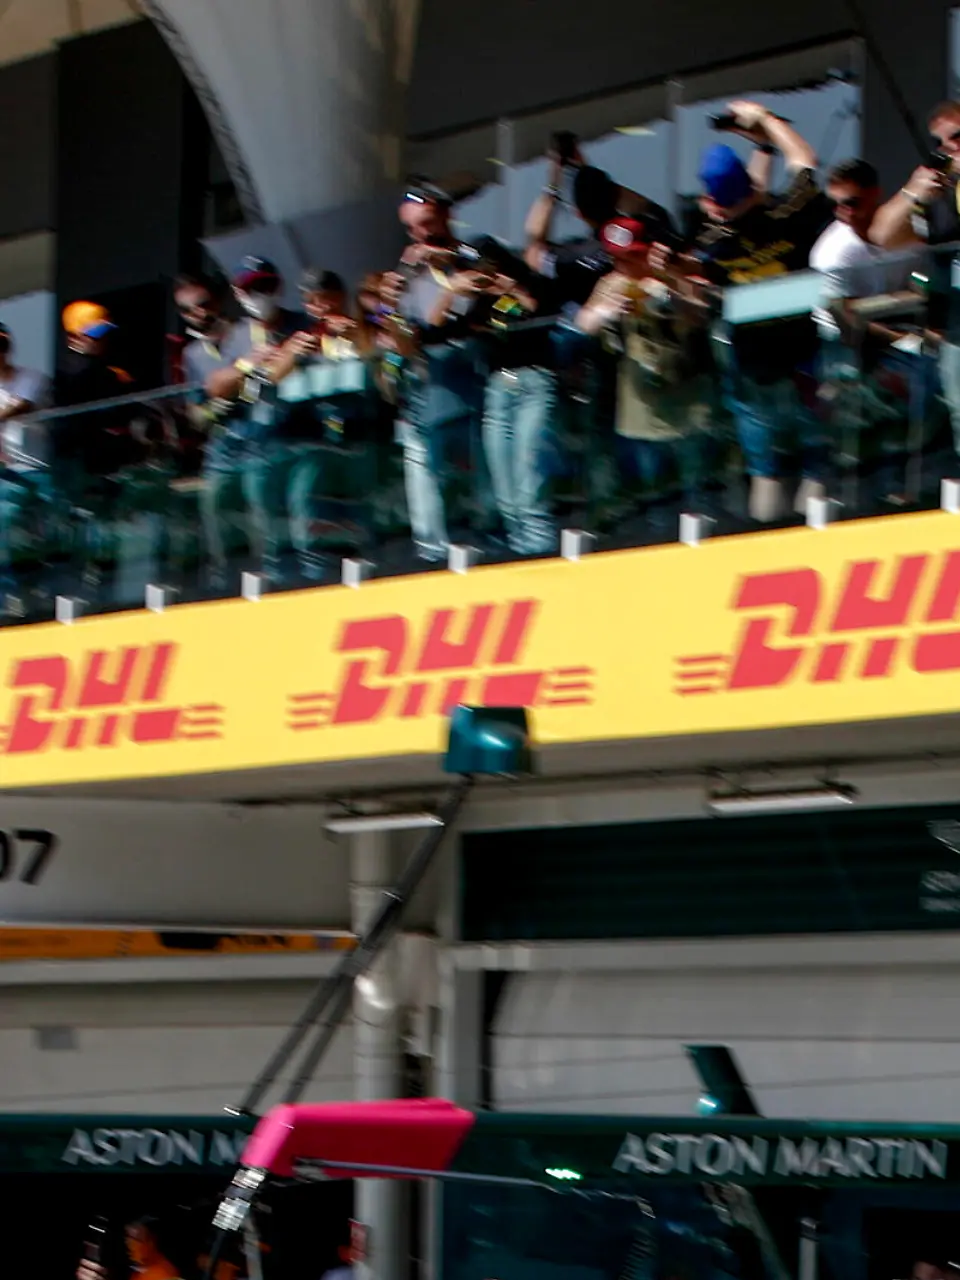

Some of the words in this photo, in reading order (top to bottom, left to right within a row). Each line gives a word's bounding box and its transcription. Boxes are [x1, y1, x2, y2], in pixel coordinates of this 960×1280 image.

[3, 640, 182, 755] DHL
[331, 598, 545, 726] DHL
[61, 1127, 204, 1166] ASTON
[612, 1132, 767, 1177] ASTON
[773, 1137, 948, 1179] MARTIN
